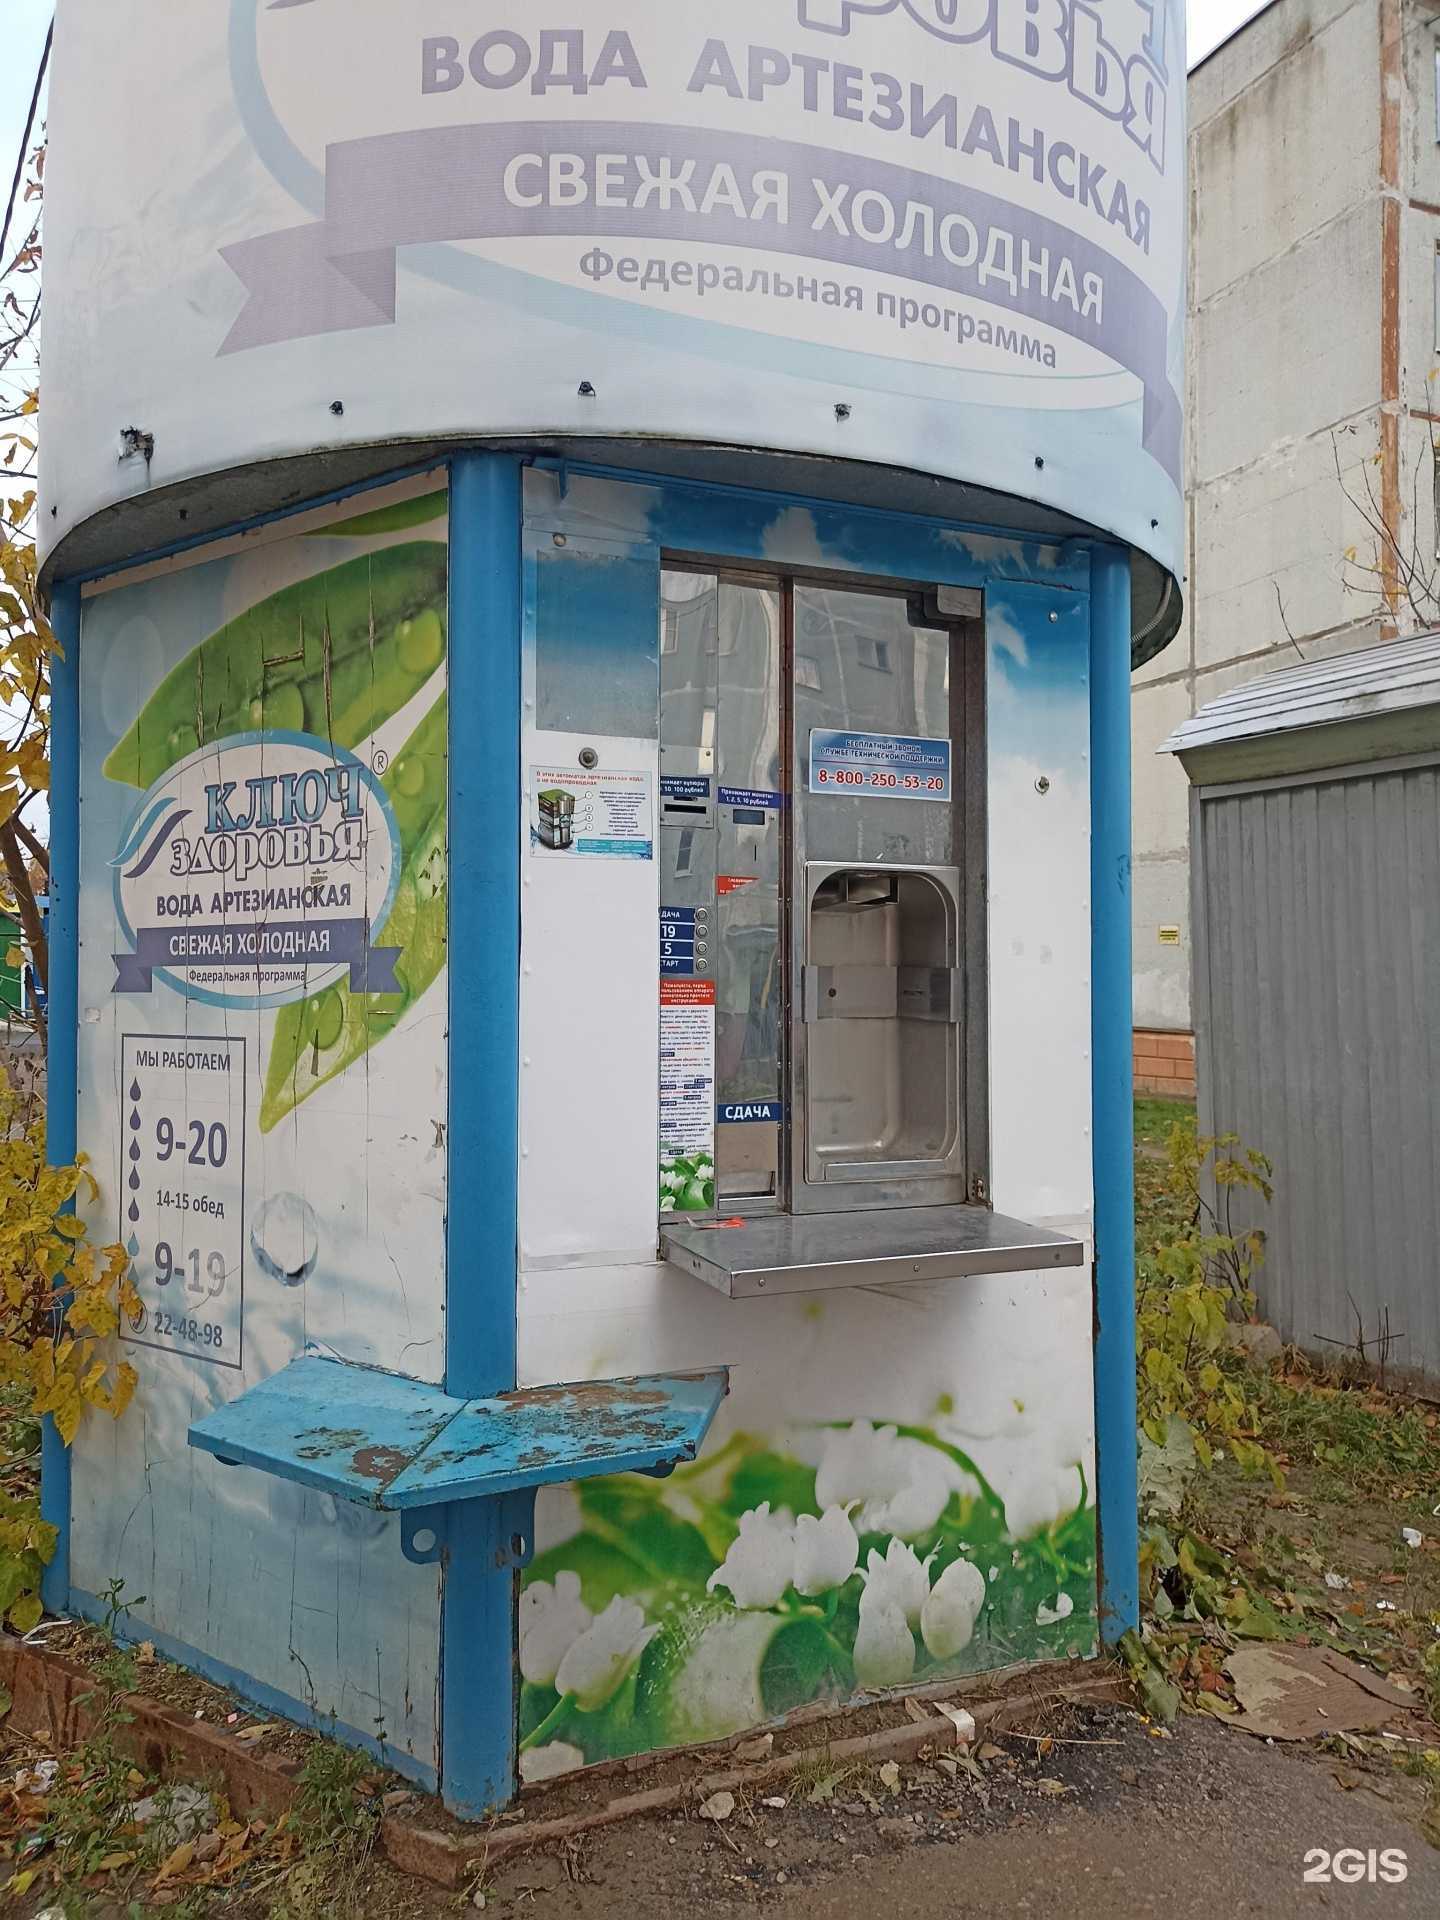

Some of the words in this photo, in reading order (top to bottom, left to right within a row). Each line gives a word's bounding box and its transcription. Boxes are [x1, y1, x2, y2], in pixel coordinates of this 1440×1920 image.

[421, 29, 648, 96] ВОДА
[686, 37, 1151, 256] АРТЕЗИАНСКАЯ
[503, 151, 789, 225] СВЕЖАЯ
[811, 177, 1104, 325] ХОЛОДНАЯ
[579, 247, 864, 311] Федеральная
[876, 291, 1056, 369] программа
[818, 769, 944, 791] 8-800-250-53-20
[204, 764, 365, 834] КЛЮЧ
[170, 819, 363, 881] ЗДОРОВЬЯ
[156, 892, 203, 917] ВОДА
[210, 883, 351, 914] АРТЕЗИАНСКАЯ
[169, 932, 234, 957] СВЕЖАЯ
[237, 929, 330, 958] ХОЛОДНАЯ
[662, 925, 676, 938] 19
[664, 942, 672, 955] 5
[189, 970, 250, 983] Федеральная
[252, 970, 306, 983] программа
[135, 1049, 160, 1068] МЫ
[162, 1050, 231, 1072] РАБОТАЕМ
[725, 1103, 771, 1120] СДАЧА
[155, 1116, 228, 1169] 9-20
[156, 1188, 190, 1211] 14-15
[192, 1194, 225, 1219] обед
[154, 1240, 226, 1298] 9-19
[153, 1310, 223, 1349] 22-48-98
